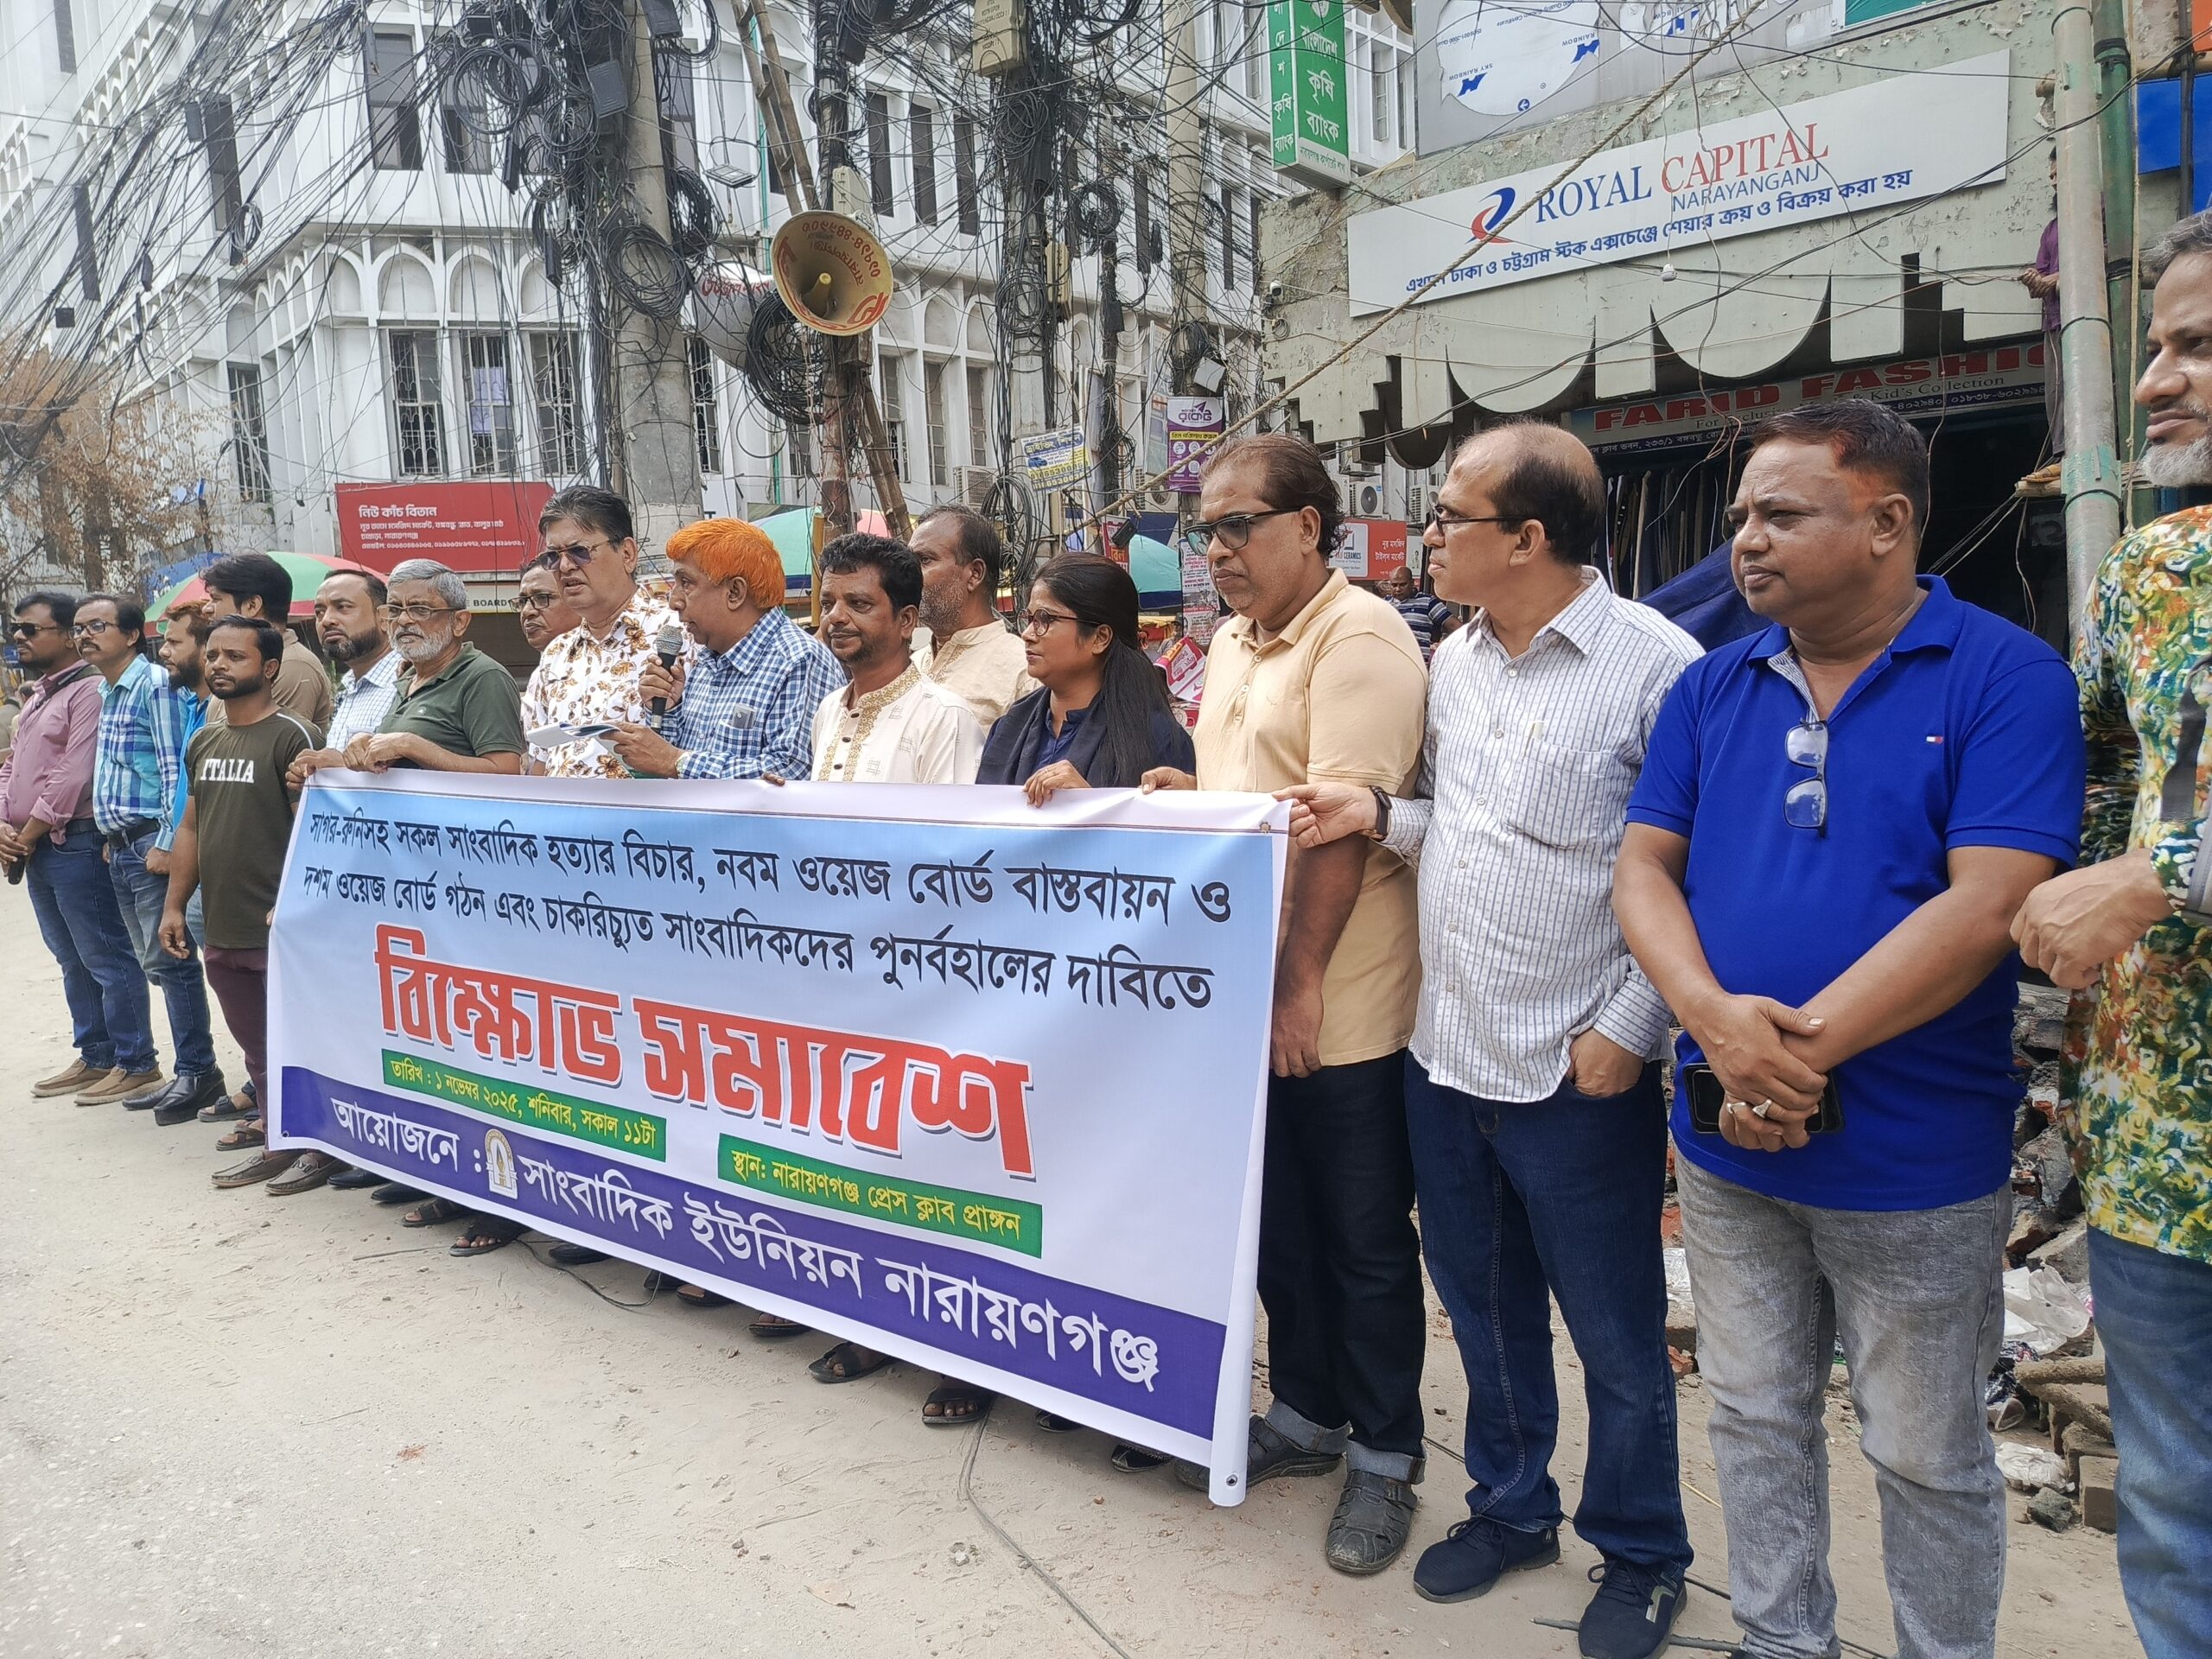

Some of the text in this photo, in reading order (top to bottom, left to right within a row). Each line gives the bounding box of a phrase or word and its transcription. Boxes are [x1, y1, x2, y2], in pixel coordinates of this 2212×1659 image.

[1300, 25, 1338, 64] বাংলাদেশ
[1561, 32, 1595, 47] RAINBOW
[1306, 70, 1335, 105] কৃষি
[1448, 63, 1493, 81] SKY RAINBOW
[1274, 133, 1294, 153] ব্যাংক
[1306, 110, 1339, 143] ব্যাংক
[1535, 123, 1829, 224] ROYAL CAPITAL
[1673, 163, 1820, 213] NARAYANGANJ
[1451, 264, 1483, 283] ঢাকা
[1486, 261, 1497, 274] ও
[1502, 248, 1552, 271] চট্টগ্রাম
[1590, 226, 1657, 251] এক্সচেঞ্জে
[1662, 213, 1713, 238] শেয়ার
[1719, 204, 1754, 226] ক্রয়
[1756, 200, 1771, 216] ও
[1777, 186, 1834, 213] বিক্রয়
[1839, 177, 1878, 200] করা
[1882, 169, 1913, 188] হয়
[1593, 385, 1780, 432] FARID
[1696, 419, 1719, 429] For
[1918, 375, 2005, 395] Colection
[359, 504, 437, 518] নিউ কাঁচ বিতান
[200, 758, 254, 784] ITALIA
[309, 807, 1232, 925] সাগর-রুনিসহ সকল সাংবাদিক হত্যার বিচার, নবম ওয়েজ বোর্ড বাস্তবায়ন ও
[303, 864, 1214, 1012] দশম ওয়েজ বোর্ড গঠন এবং চাকরিচ্যুত সাংবাদিকদের পুনর্বহালের দাবিতে
[374, 923, 1036, 1180] বিক্ষোভ সমাবেশ
[390, 1059, 423, 1084] তারিখ
[435, 1072, 442, 1090] ১
[445, 1074, 480, 1103] নভেম্বর
[528, 1091, 576, 1132] শনিবার,
[582, 1111, 618, 1137] সকাল
[623, 1120, 656, 1148] ১১টা
[772, 1160, 859, 1206] নারায়ণগঞ্জ
[868, 1185, 907, 1212] প্রেস
[913, 1194, 956, 1225] ক্লাব
[330, 1096, 460, 1173] আয়োজনে
[518, 1154, 673, 1240] সাংবাদিক
[683, 1191, 863, 1299] ইউনিয়ন
[875, 1255, 1160, 1392] নারায়ণগঞ্জ
